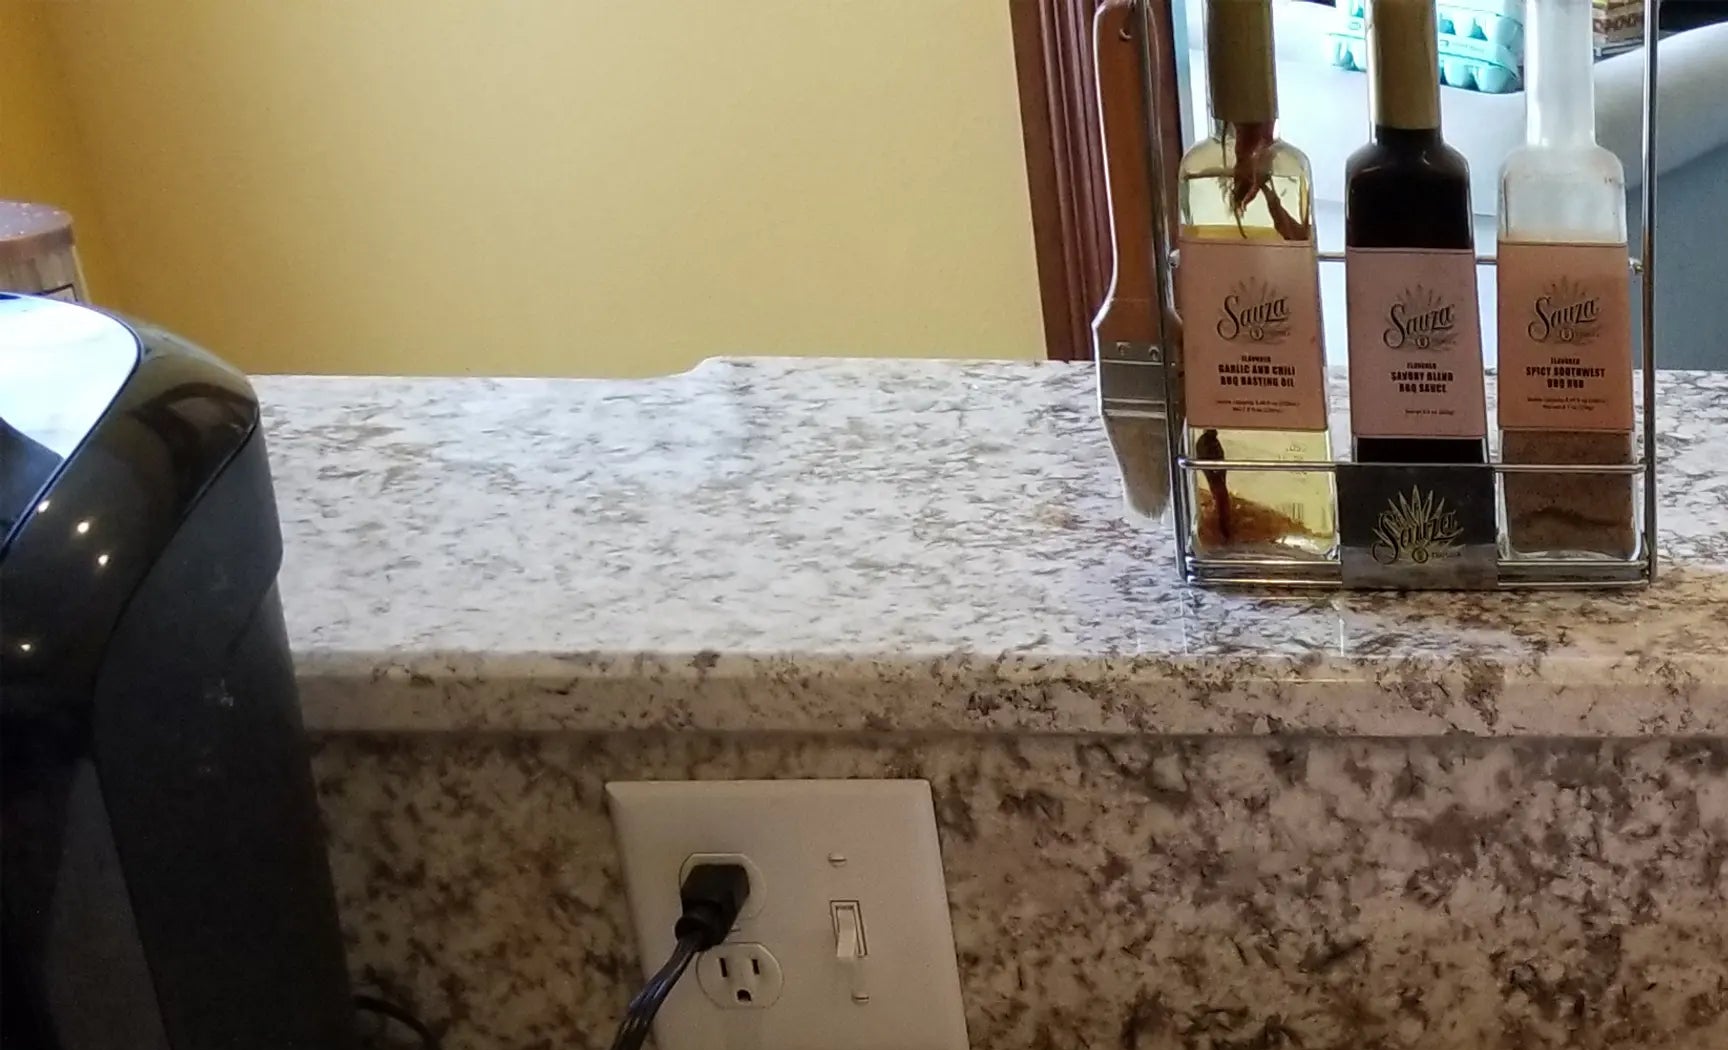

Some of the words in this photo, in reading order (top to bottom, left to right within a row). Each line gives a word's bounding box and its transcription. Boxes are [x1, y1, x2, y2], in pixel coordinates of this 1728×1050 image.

[1216, 294, 1291, 340] Sauza
[1528, 296, 1599, 342] Sauza
[1383, 303, 1455, 349] Sauza
[1218, 364, 1250, 374] GARLIC
[1252, 365, 1270, 375] AND
[1272, 366, 1295, 376] CHILI
[1391, 371, 1424, 381] SAVORY
[1426, 372, 1453, 381] BLEND
[1526, 366, 1551, 376] SPICY
[1554, 367, 1606, 378] SOUTHWEST
[1220, 376, 1239, 387] BBQ
[1241, 376, 1278, 387] BASTING
[1281, 377, 1295, 387] OIL
[1567, 379, 1584, 389] RUB
[1399, 383, 1417, 393] BBQ
[1419, 383, 1447, 393] SAUCE
[1372, 510, 1458, 564] Sauza
